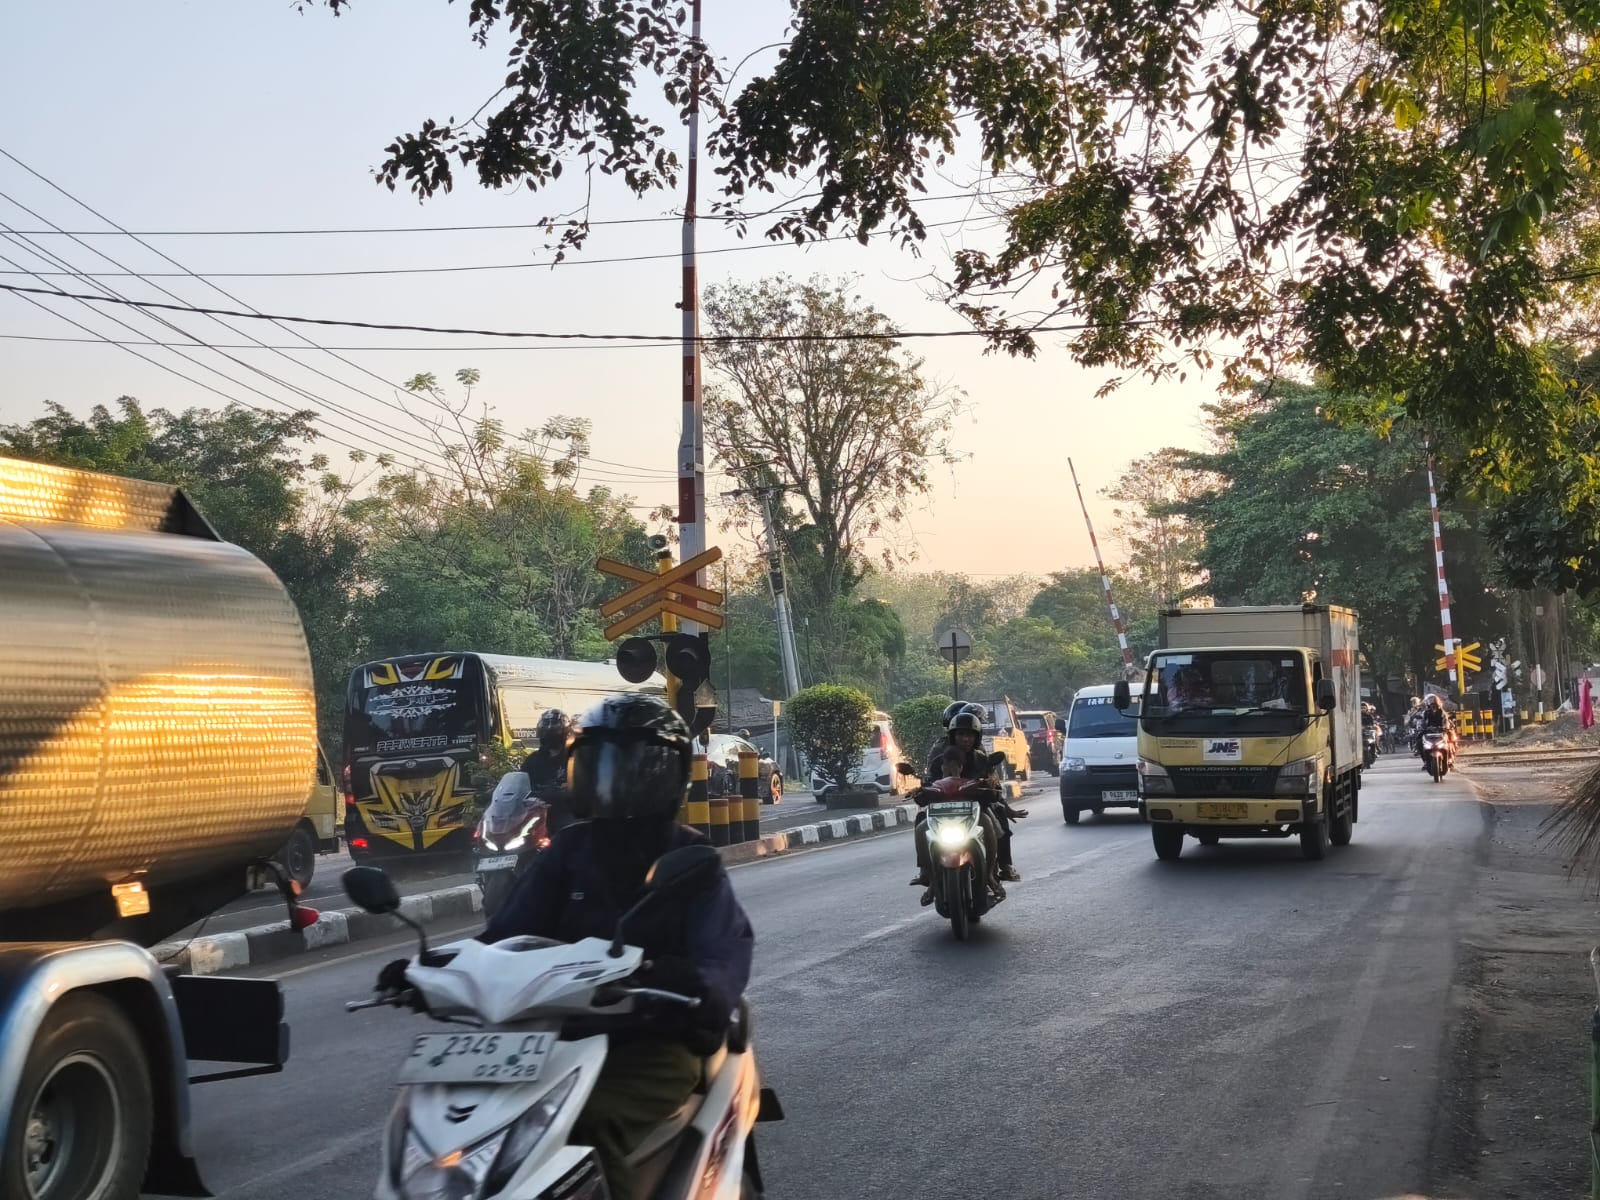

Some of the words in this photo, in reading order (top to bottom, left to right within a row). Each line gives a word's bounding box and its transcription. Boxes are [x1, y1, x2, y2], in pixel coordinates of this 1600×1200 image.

[376, 735, 448, 753] PARIWISATA
[1208, 742, 1240, 754] JNE
[410, 1036, 430, 1057] E
[441, 1035, 502, 1057] 2346
[520, 1034, 546, 1055] CL
[474, 1063, 538, 1078] 02-28
